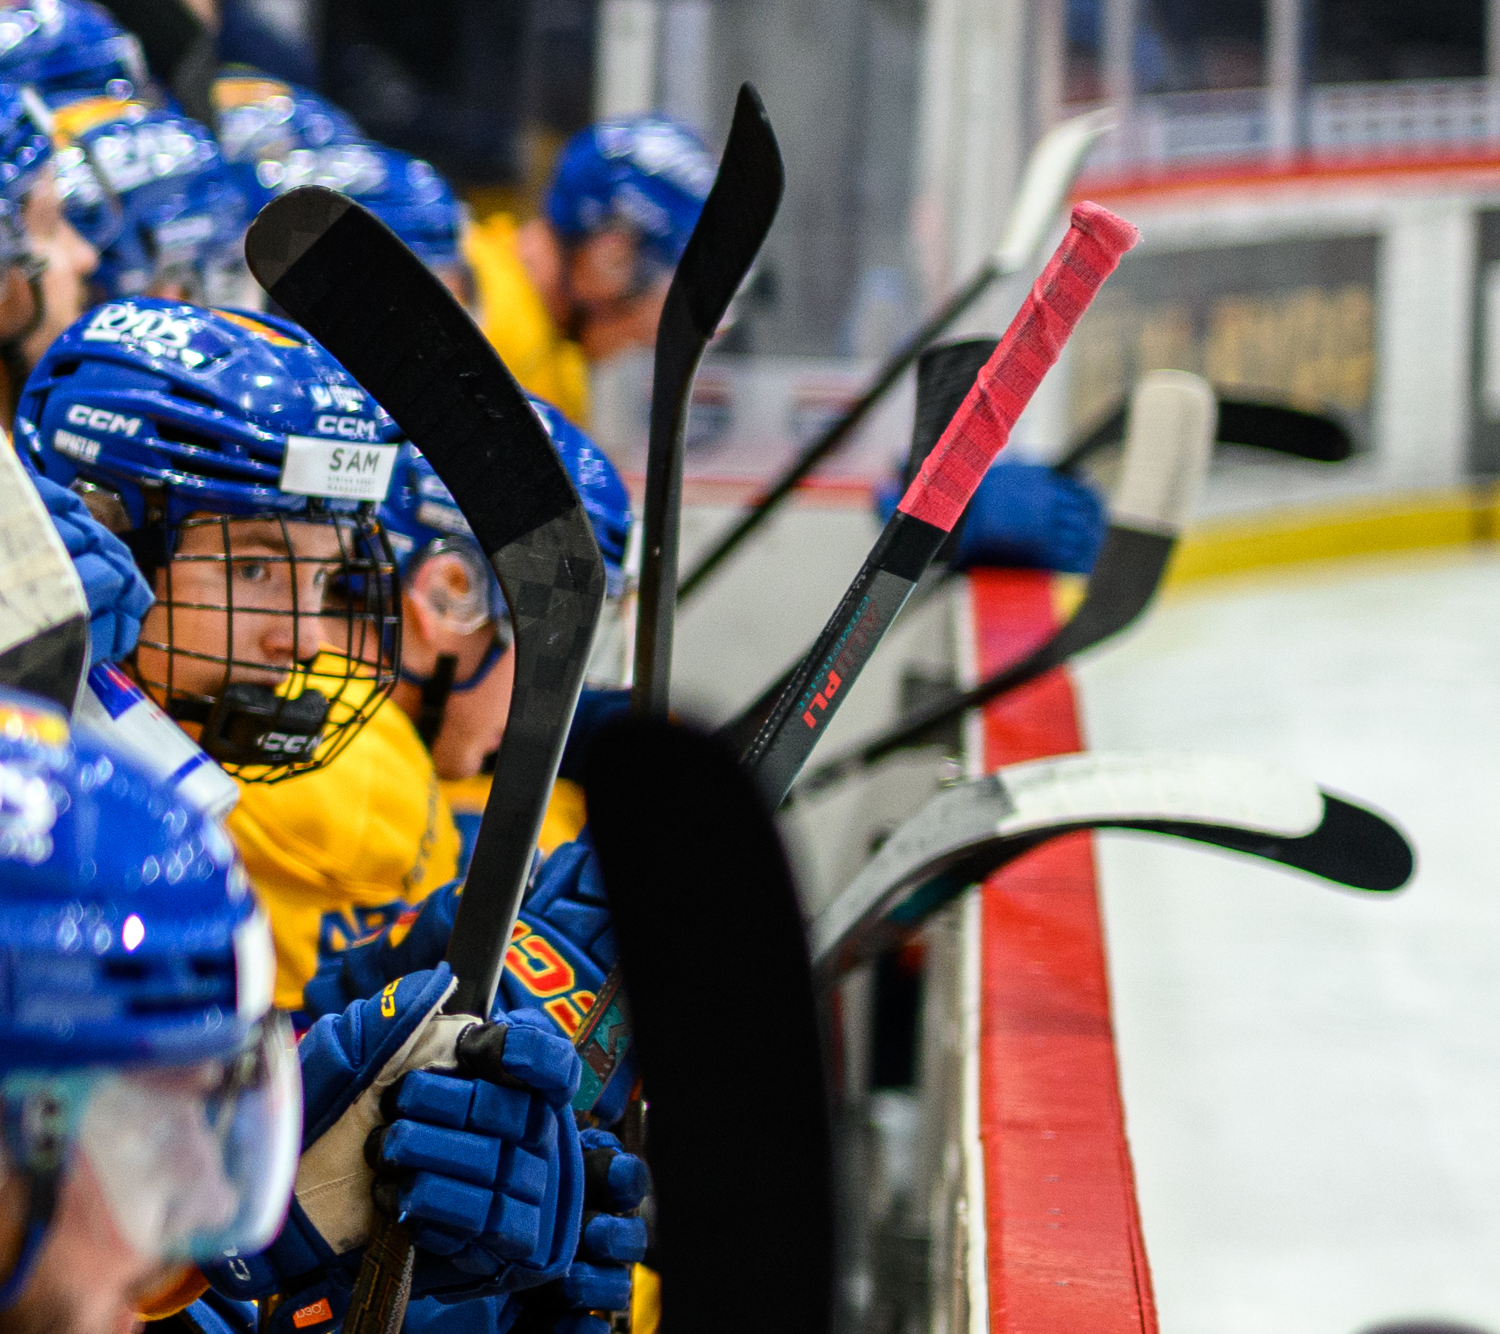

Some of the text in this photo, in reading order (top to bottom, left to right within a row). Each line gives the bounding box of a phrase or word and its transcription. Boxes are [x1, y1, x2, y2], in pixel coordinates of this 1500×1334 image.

[67, 403, 143, 438] CCM
[316, 414, 377, 437] CCM
[328, 447, 381, 474] SAM
